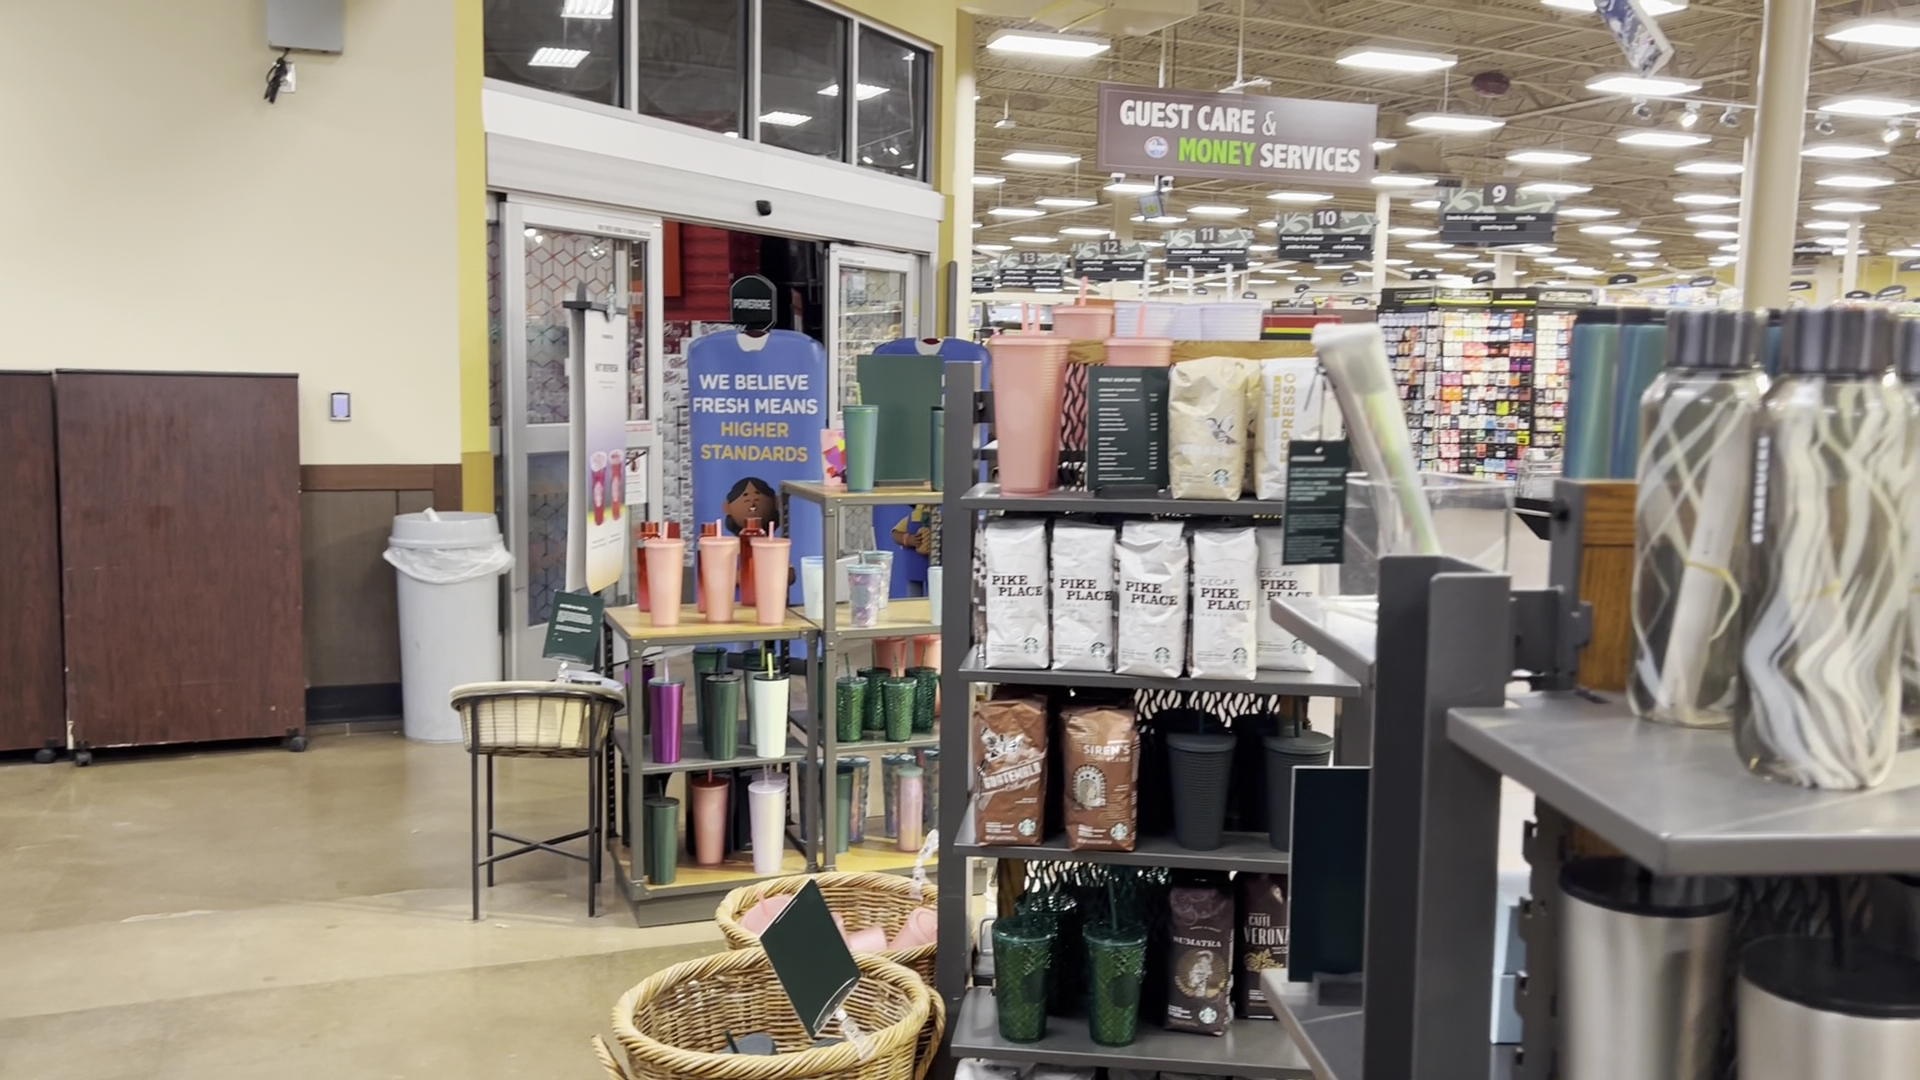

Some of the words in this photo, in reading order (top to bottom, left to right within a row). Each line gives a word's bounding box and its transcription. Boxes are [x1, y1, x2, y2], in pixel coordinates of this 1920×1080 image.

[1120, 99, 1193, 129] GUEST
[1197, 105, 1255, 134] CARE
[1262, 111, 1277, 136] &
[1178, 137, 1256, 166] MONEY
[1260, 143, 1361, 173] SERVICES
[1492, 185, 1507, 203] 9
[1316, 210, 1337, 226] 10
[1200, 227, 1215, 241] 11
[1103, 241, 1118, 253] 12
[1022, 252, 1036, 264] 13
[699, 374, 730, 390] WE
[735, 374, 809, 391] BELIEVE
[693, 397, 749, 413] FRESH
[755, 398, 818, 415] MEANS
[1279, 373, 1296, 463] ESPRESSO
[720, 421, 789, 438] HIGHER
[701, 445, 808, 462] STANDARDS
[992, 575, 1028, 586] PIKE
[1260, 570, 1294, 578] DECAF
[1060, 579, 1097, 589] PIKE
[1125, 581, 1162, 594] PIKE
[1200, 578, 1236, 586] DECAF
[1260, 580, 1298, 590] PIKE
[998, 586, 1043, 597] PLACE
[1067, 591, 1113, 601] PLACE
[1201, 588, 1239, 599] PIKE
[1131, 593, 1178, 606] PLACE
[1083, 744, 1130, 756] SIREN'S
